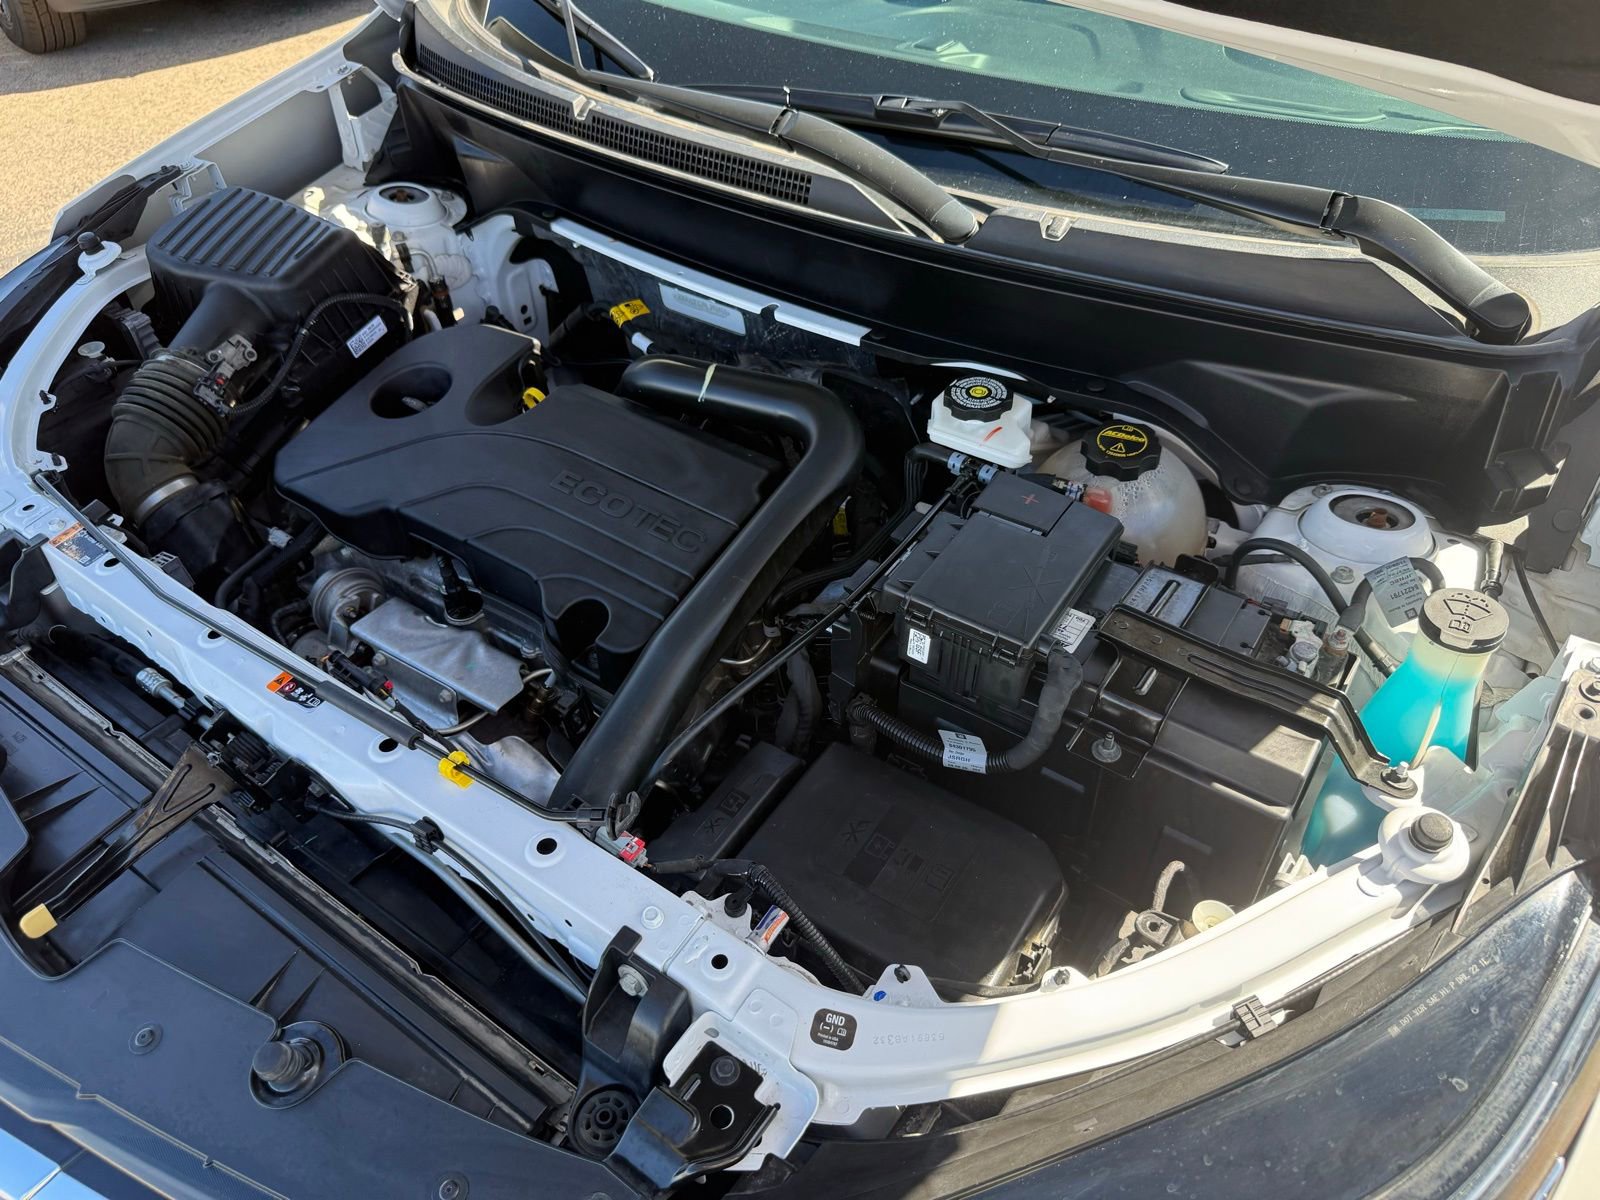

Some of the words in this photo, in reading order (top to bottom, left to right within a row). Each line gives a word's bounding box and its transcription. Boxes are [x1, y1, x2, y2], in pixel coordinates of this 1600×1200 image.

[1100, 430, 1146, 443] ACDelco
[550, 469, 707, 552] ECOTEC
[825, 1013, 846, 1026] GND
